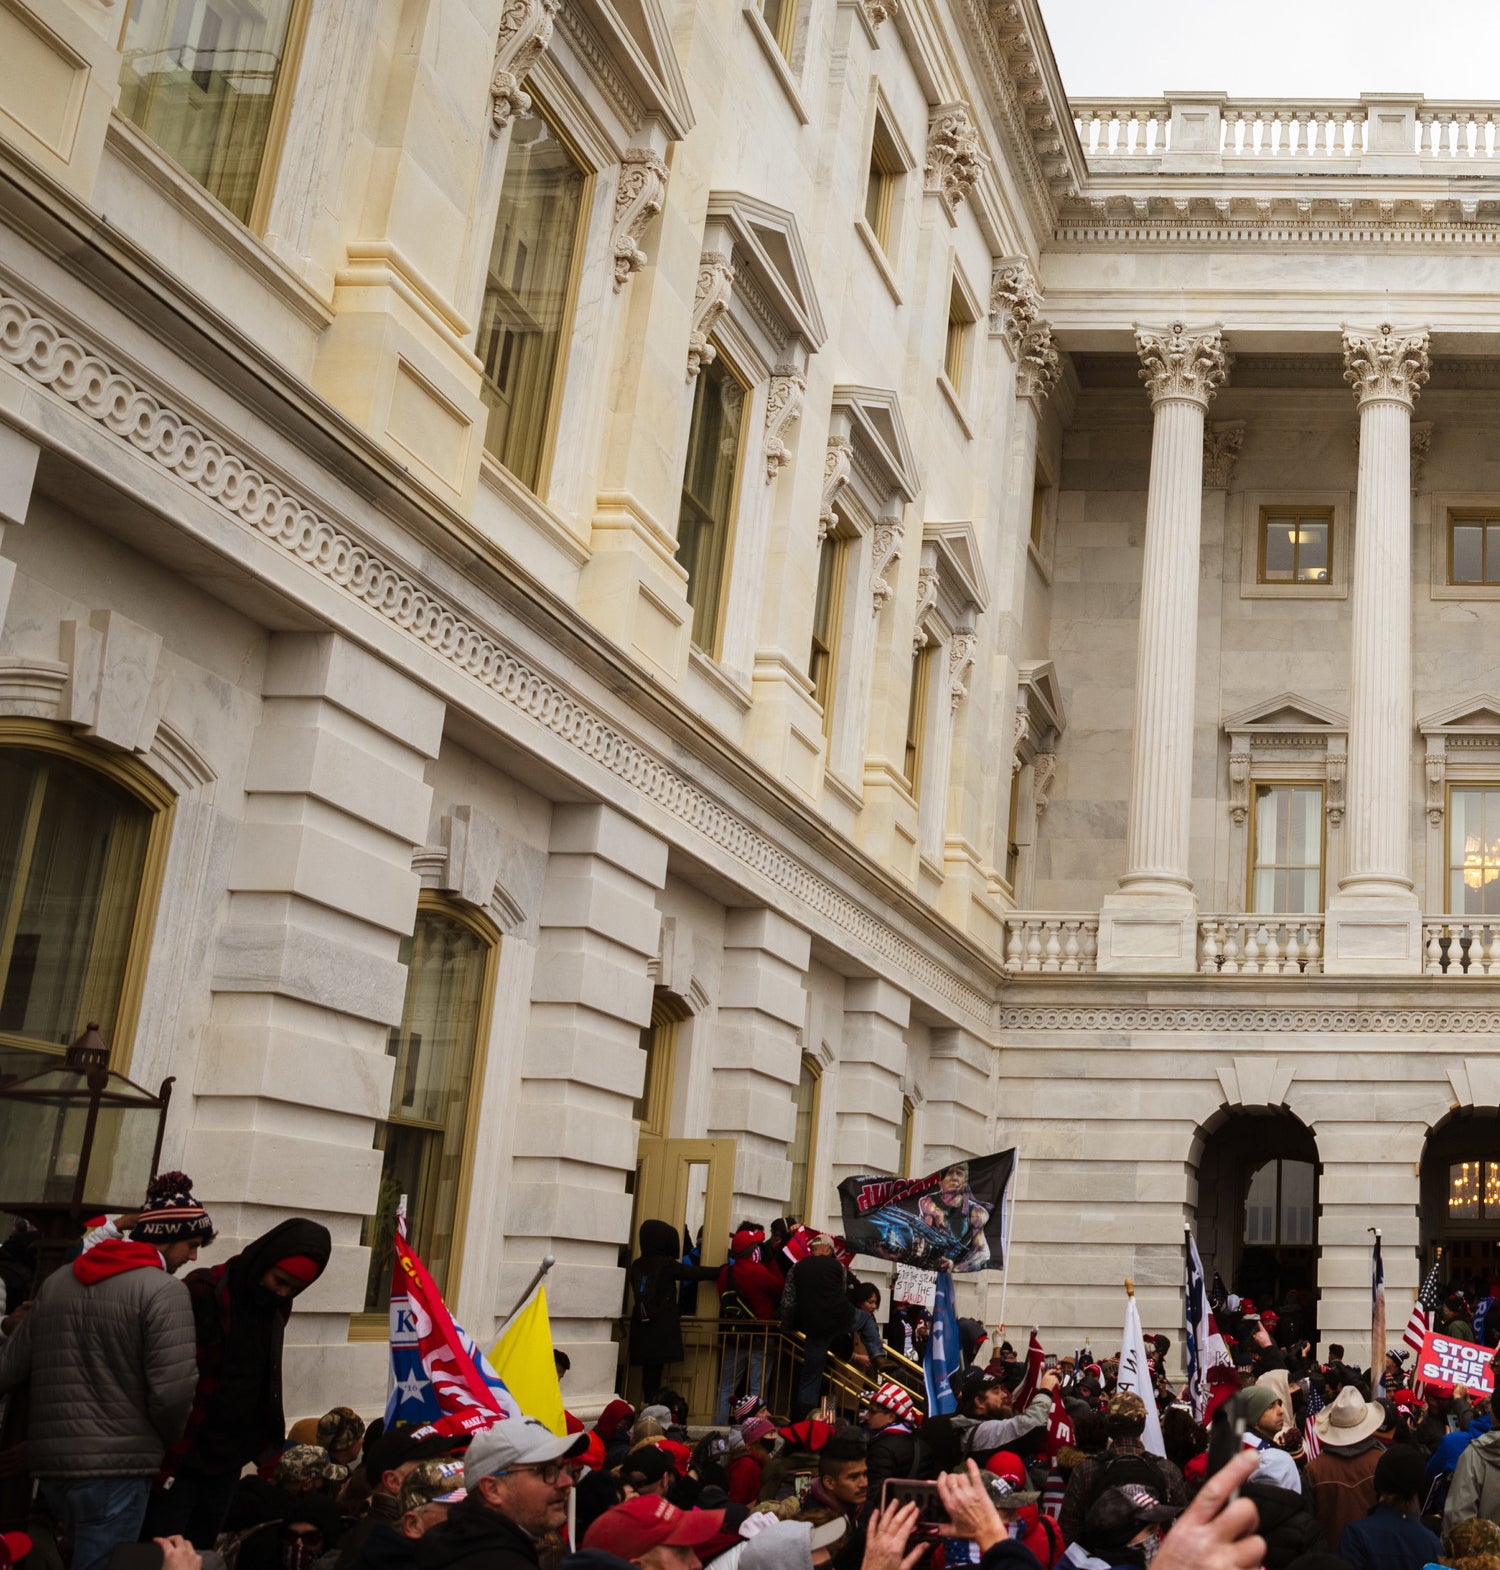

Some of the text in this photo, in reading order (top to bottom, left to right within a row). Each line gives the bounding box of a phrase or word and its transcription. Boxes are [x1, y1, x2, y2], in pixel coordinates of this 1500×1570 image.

[143, 1217, 212, 1234] NEW YOR
[917, 1282, 933, 1296] THE
[1432, 1339, 1493, 1363] STOP
[1439, 1353, 1484, 1377] THE
[1423, 1363, 1495, 1393] STEAL
[461, 1416, 481, 1429] MAKE
